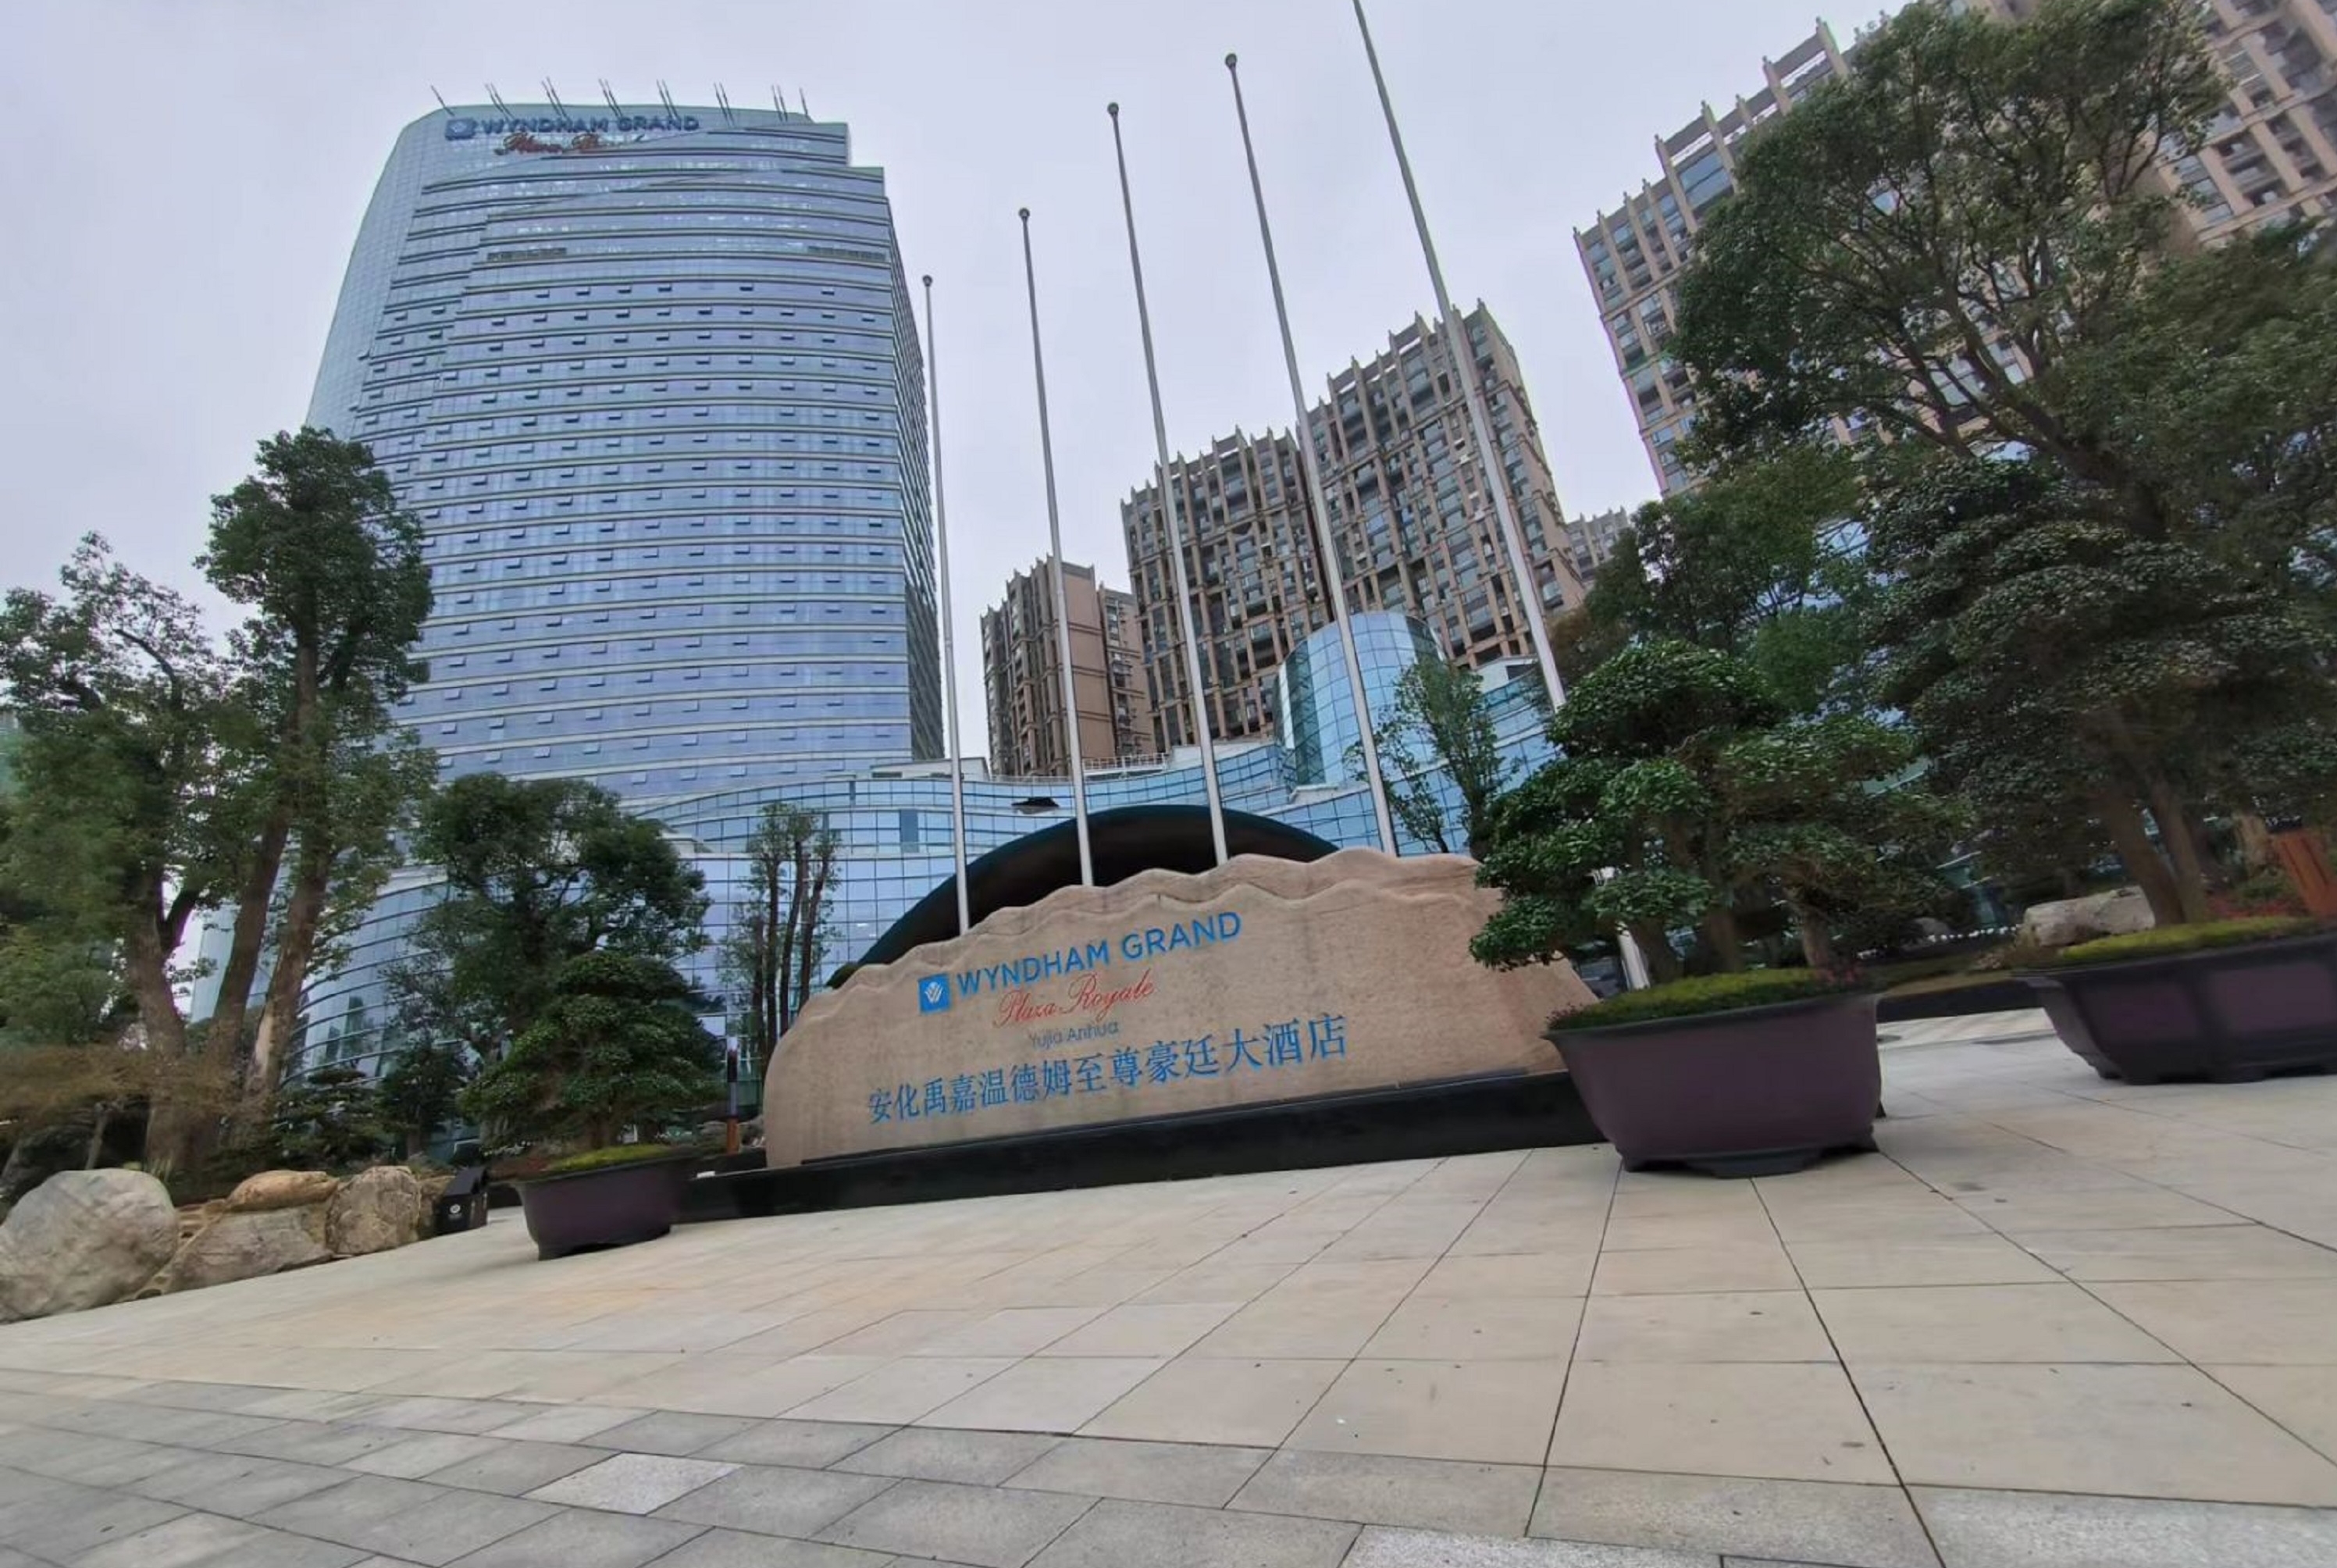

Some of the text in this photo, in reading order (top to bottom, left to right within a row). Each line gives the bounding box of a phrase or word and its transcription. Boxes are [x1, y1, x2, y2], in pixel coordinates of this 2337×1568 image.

[483, 116, 700, 134] WYNDHAM GRAND
[956, 911, 1242, 996] WYNDHAM GRAND
[992, 968, 1155, 1028] Plaza Royale
[1028, 1021, 1119, 1050] Yujia Anhua
[868, 1014, 1346, 1123] 安化禹嘉温德姆至尊豪廷大酒店
